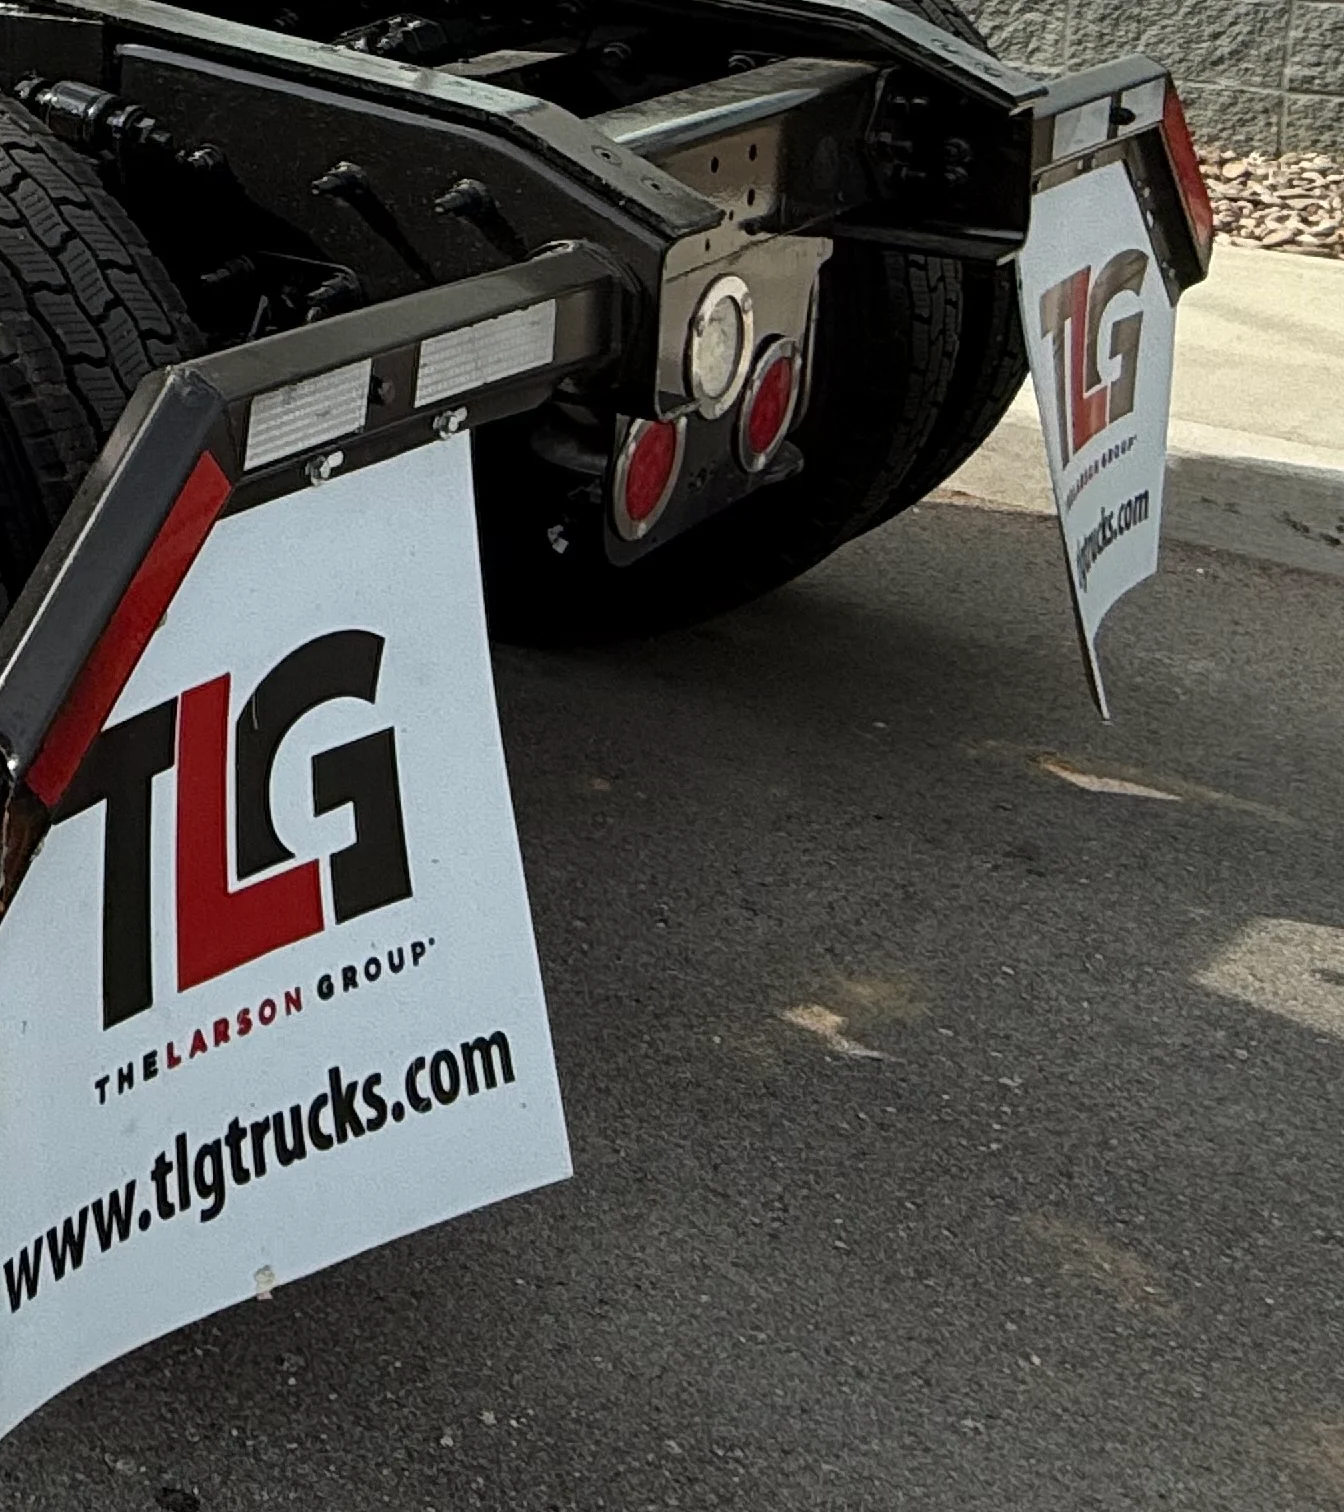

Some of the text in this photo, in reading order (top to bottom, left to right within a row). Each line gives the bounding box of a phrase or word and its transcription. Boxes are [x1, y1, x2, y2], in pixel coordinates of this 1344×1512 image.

[1039, 248, 1149, 471] TLG
[52, 628, 413, 1031] TLG
[316, 938, 429, 1002] GROUP
[2, 1027, 517, 1315] www.tlgtrucks.com
